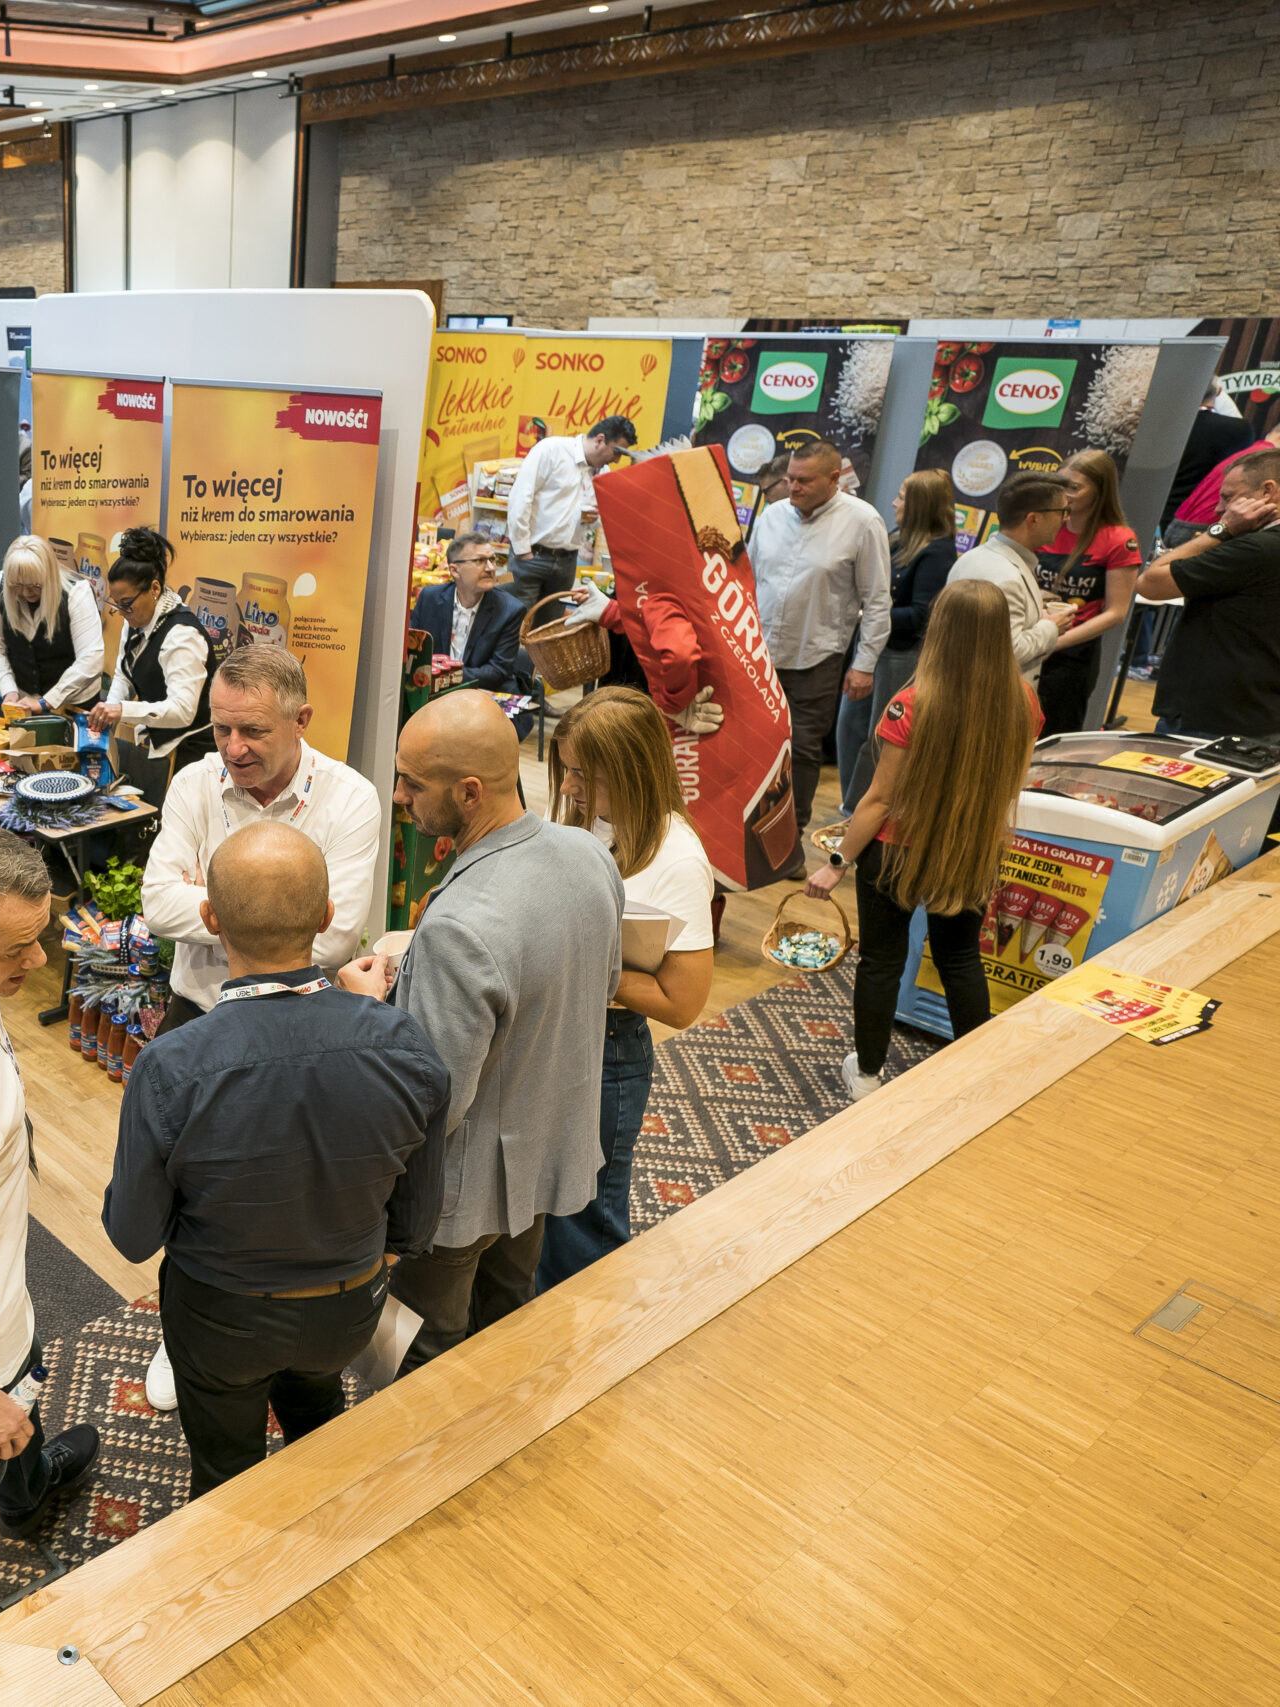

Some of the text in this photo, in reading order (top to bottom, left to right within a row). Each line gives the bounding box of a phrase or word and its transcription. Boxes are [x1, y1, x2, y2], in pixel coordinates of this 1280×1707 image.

[436, 346, 487, 364] SONKO
[535, 352, 605, 372] SONKO
[762, 374, 816, 388] CENOS
[998, 383, 1061, 400] CENOS
[116, 392, 156, 410] NOWOŚĆ!
[305, 408, 368, 429] NOWOŚĆ!
[40, 444, 102, 473] To więcej
[1018, 460, 1060, 472] WYBIER
[40, 473, 149, 491] niż krem do smarowania
[182, 468, 283, 503] To więcej
[67, 497, 86, 508] jeden
[100, 496, 140, 509] wszystkie?
[181, 504, 355, 522] niż krem do smarowania
[180, 530, 338, 545] Wybierasz: jeden czy wszystkie?
[196, 604, 227, 630] Lino
[244, 600, 278, 627] Lino
[293, 616, 326, 624] połączenie
[710, 610, 720, 624] Z
[292, 633, 331, 641] MLECZNEGO
[293, 624, 339, 633] dwóch kremów
[295, 641, 346, 651] ORZECHOWEGO
[1032, 843, 1049, 855] 1+1
[1050, 847, 1093, 867] GRATIS
[1031, 859, 1064, 878] JEDEN,
[999, 863, 1088, 898] OSTANIESZ GRATIS
[1038, 949, 1072, 970] 1,99
[983, 961, 1047, 992] GRATIS
